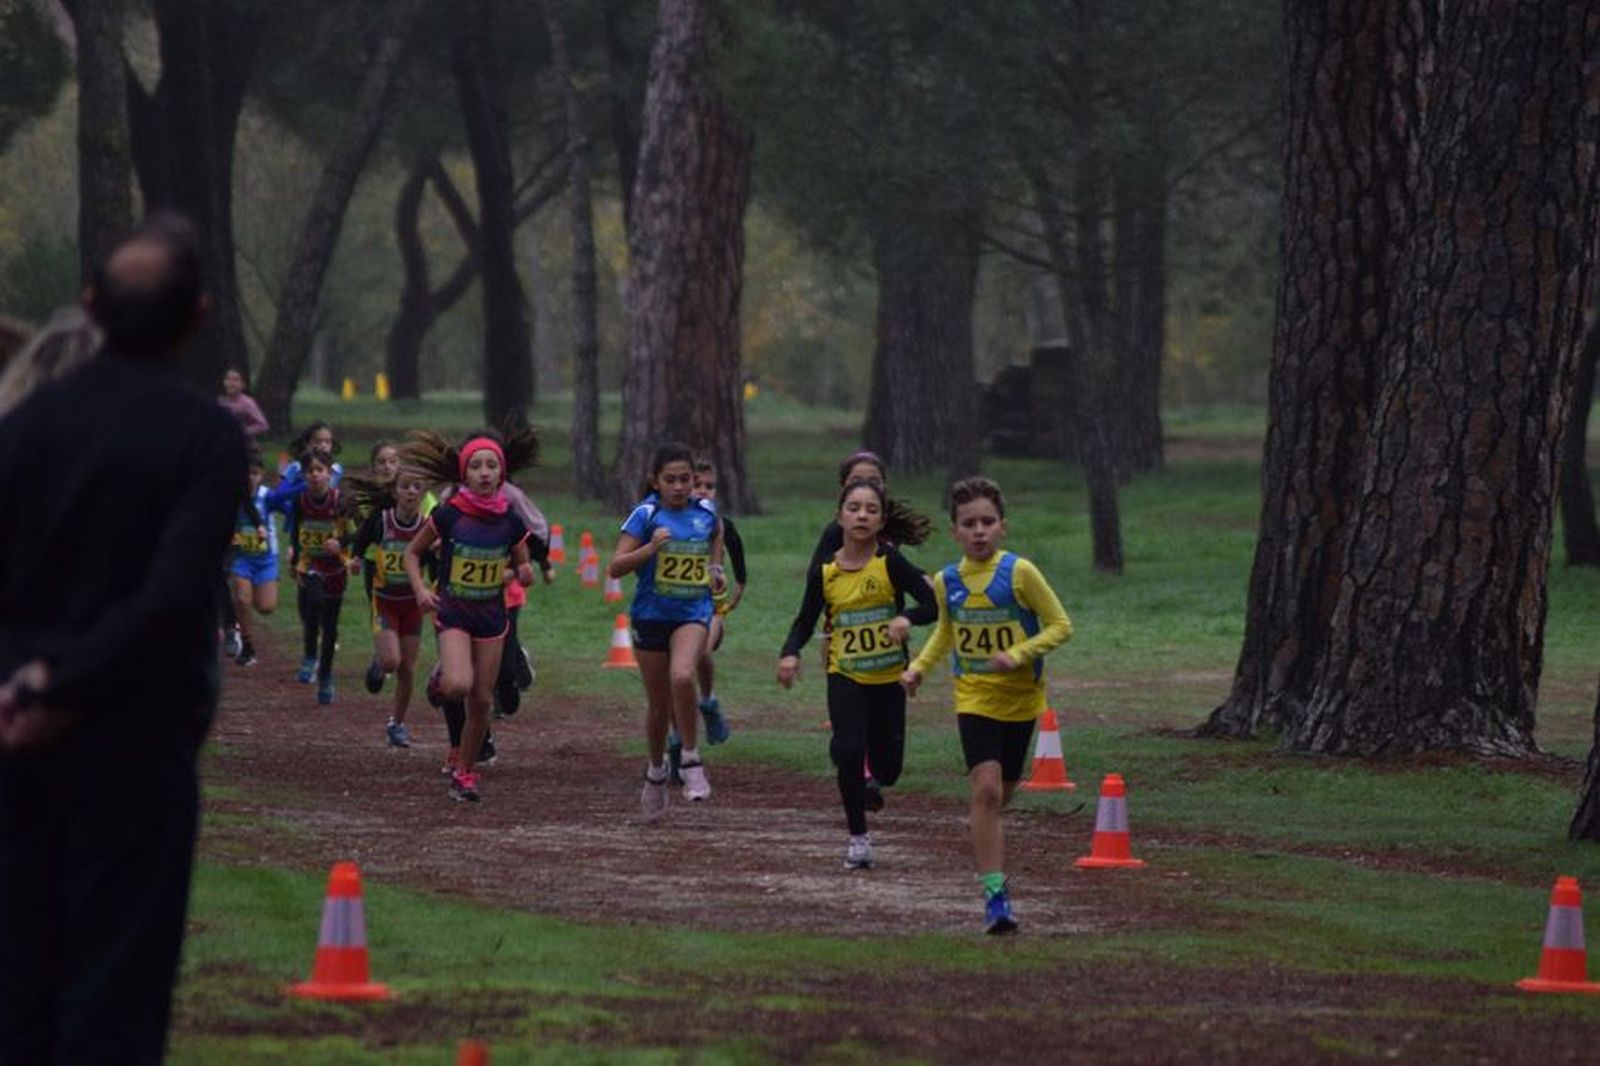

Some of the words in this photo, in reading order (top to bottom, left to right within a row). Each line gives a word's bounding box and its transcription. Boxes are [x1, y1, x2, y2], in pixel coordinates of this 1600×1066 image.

[461, 562, 499, 583] 211
[662, 556, 707, 581] 225
[842, 624, 893, 653] 203
[958, 626, 1014, 653] 240
